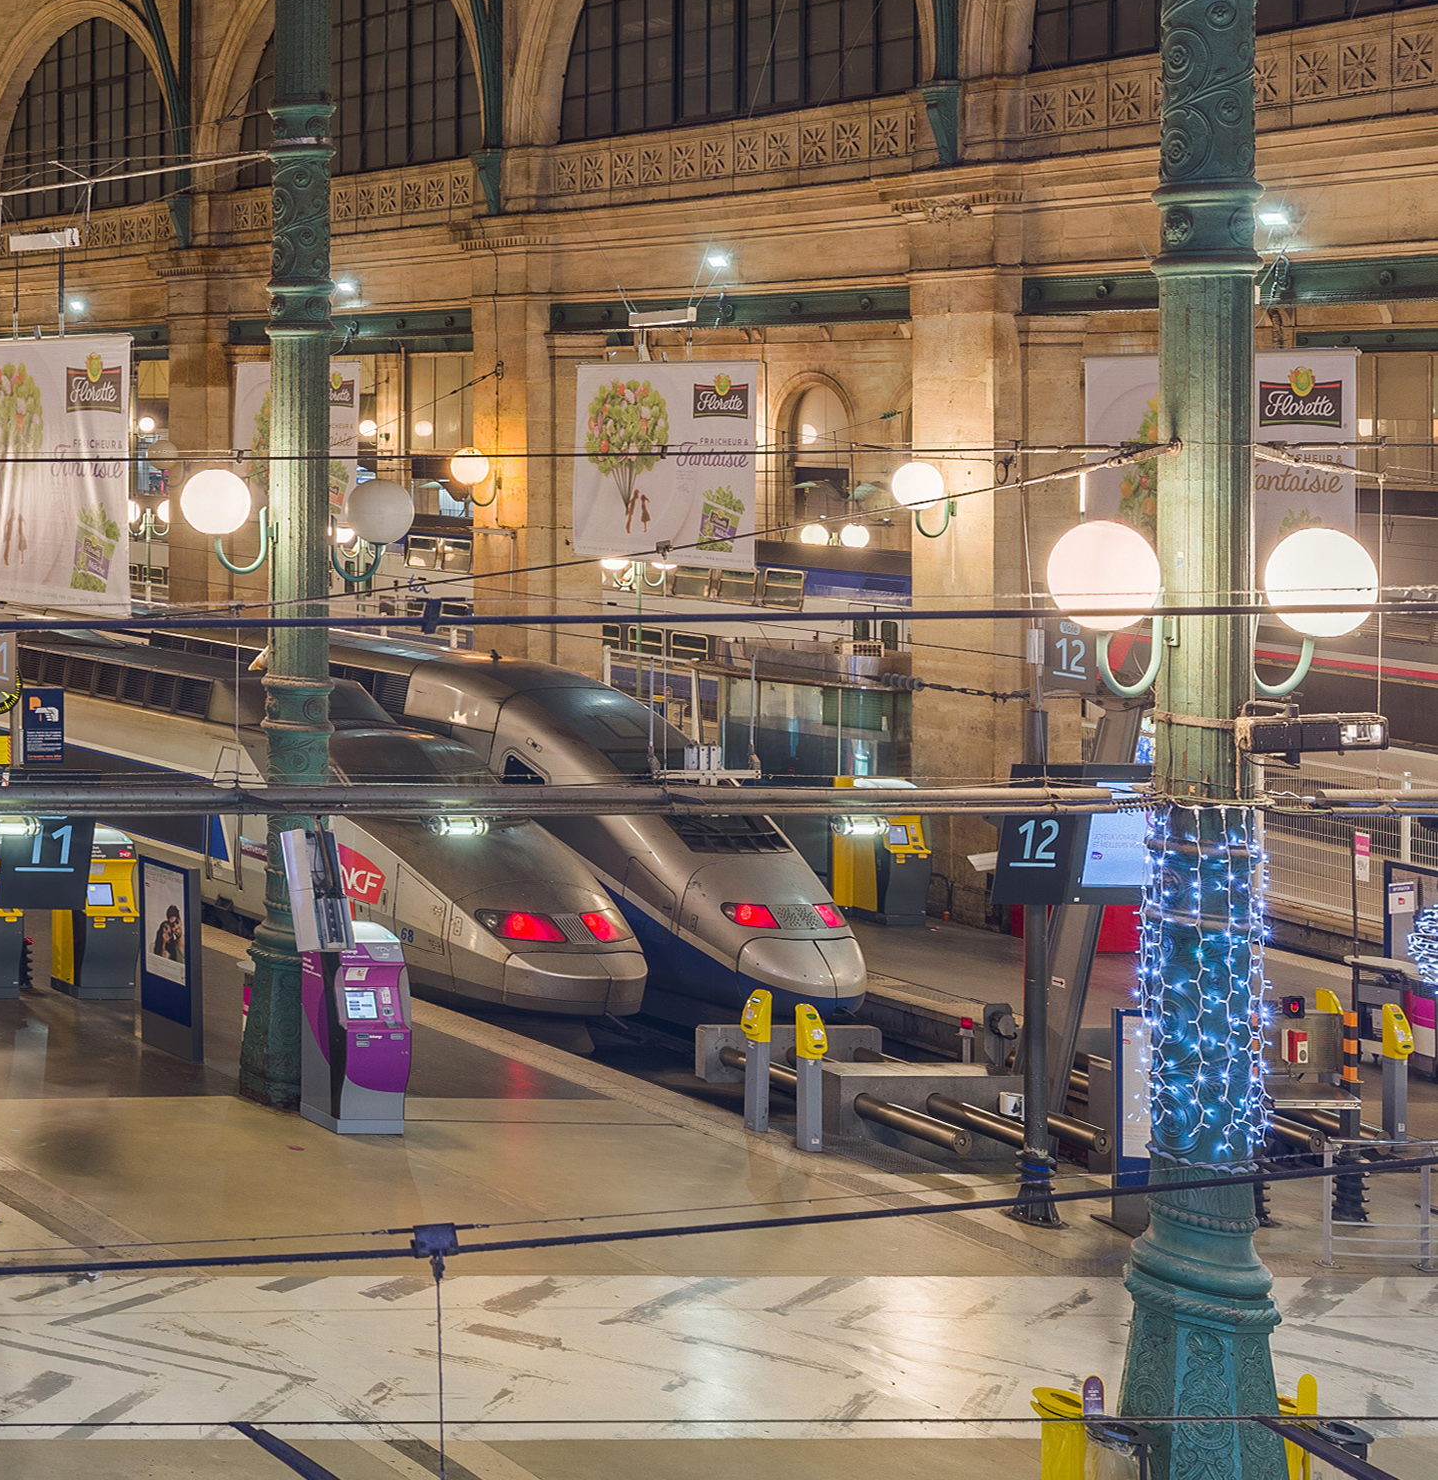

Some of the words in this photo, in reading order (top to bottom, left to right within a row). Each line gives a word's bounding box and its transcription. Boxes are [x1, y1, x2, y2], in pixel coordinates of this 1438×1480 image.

[70, 376, 117, 403] Florette
[697, 391, 744, 411] Florette
[1265, 391, 1335, 417] Florette
[676, 442, 749, 468] Fantaisie
[700, 438, 742, 446] FRAICHEUR
[1255, 464, 1343, 494] antaisie
[1062, 623, 1078, 633] Voie
[1056, 638, 1085, 673] 12
[32, 825, 72, 864] 11
[1018, 819, 1059, 860] 12
[342, 864, 381, 894] NCF
[401, 928, 414, 943] 68
